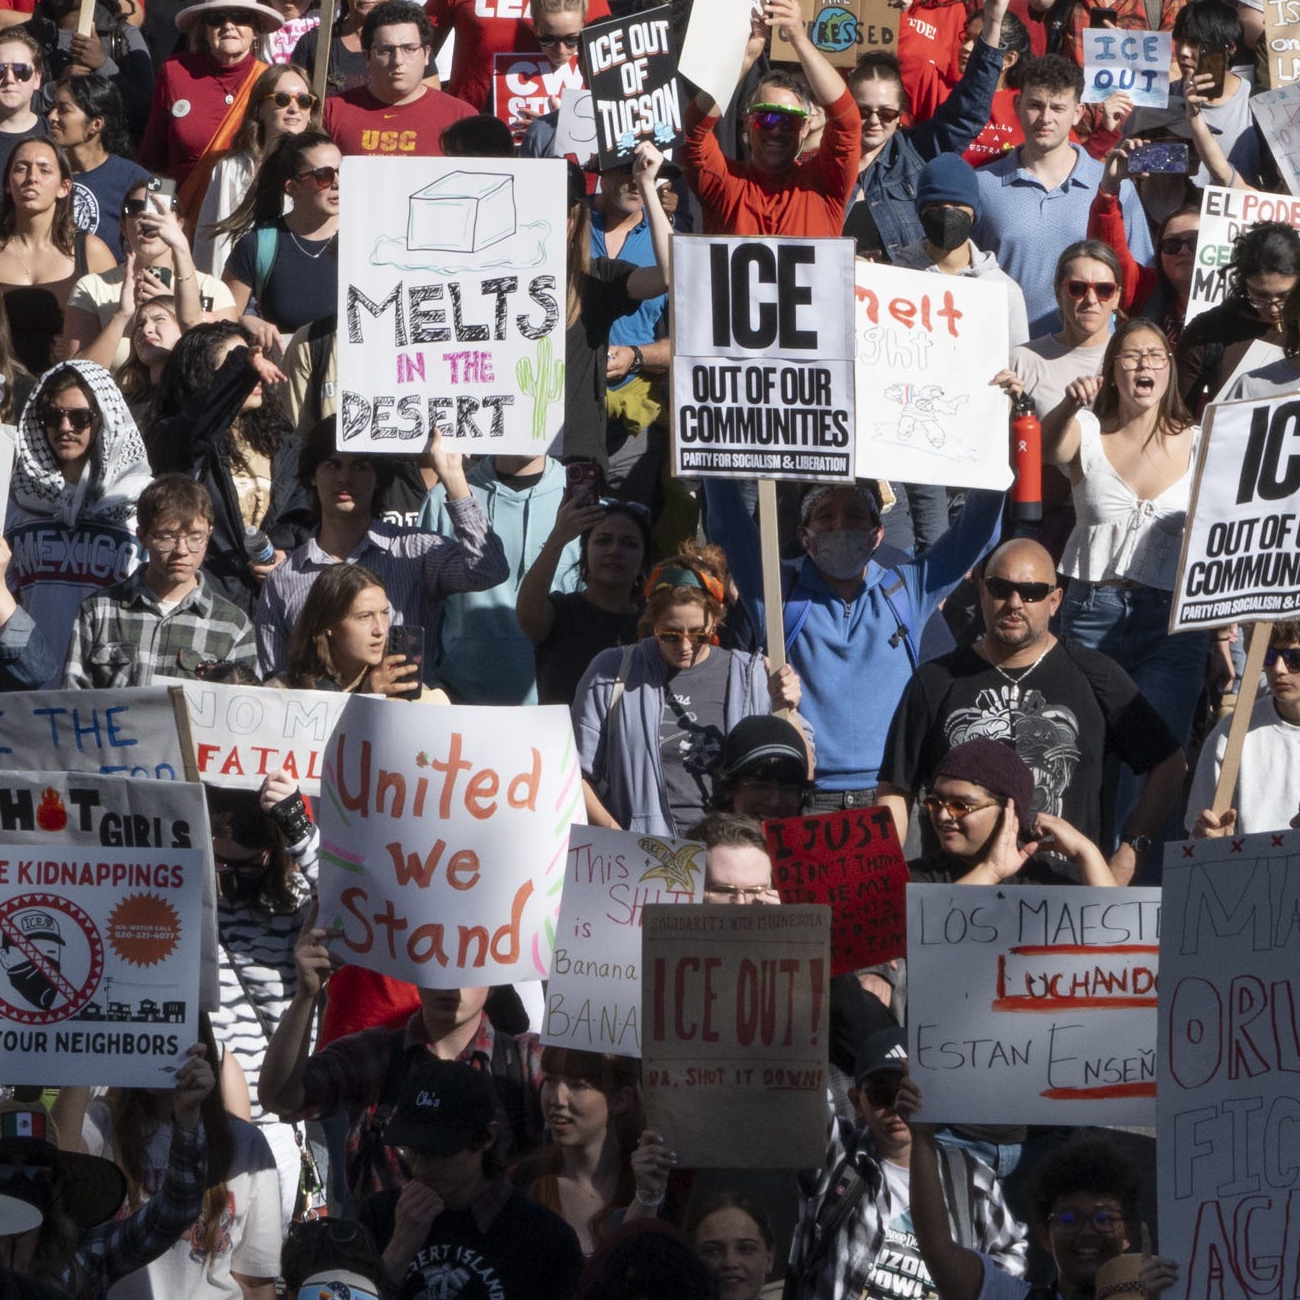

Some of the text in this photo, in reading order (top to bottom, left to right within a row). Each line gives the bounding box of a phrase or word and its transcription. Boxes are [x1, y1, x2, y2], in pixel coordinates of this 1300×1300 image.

[362, 129, 416, 153] USC
[347, 275, 557, 348] MELTS
[709, 242, 817, 351] ICE
[398, 352, 495, 384] IN THE
[693, 365, 832, 407] OUT OF OUR
[342, 395, 515, 442] DESERT
[679, 404, 848, 448] COMMUNITIES
[682, 452, 713, 469] PARTY
[714, 452, 731, 469] FOR
[732, 452, 780, 470] SOCIALISM
[795, 455, 846, 473] LIBERATION
[336, 733, 538, 821] United
[17, 861, 184, 888] KIDNAPPINGS
[342, 880, 534, 969] Stand
[55, 1032, 179, 1056] NEIGHBORS
